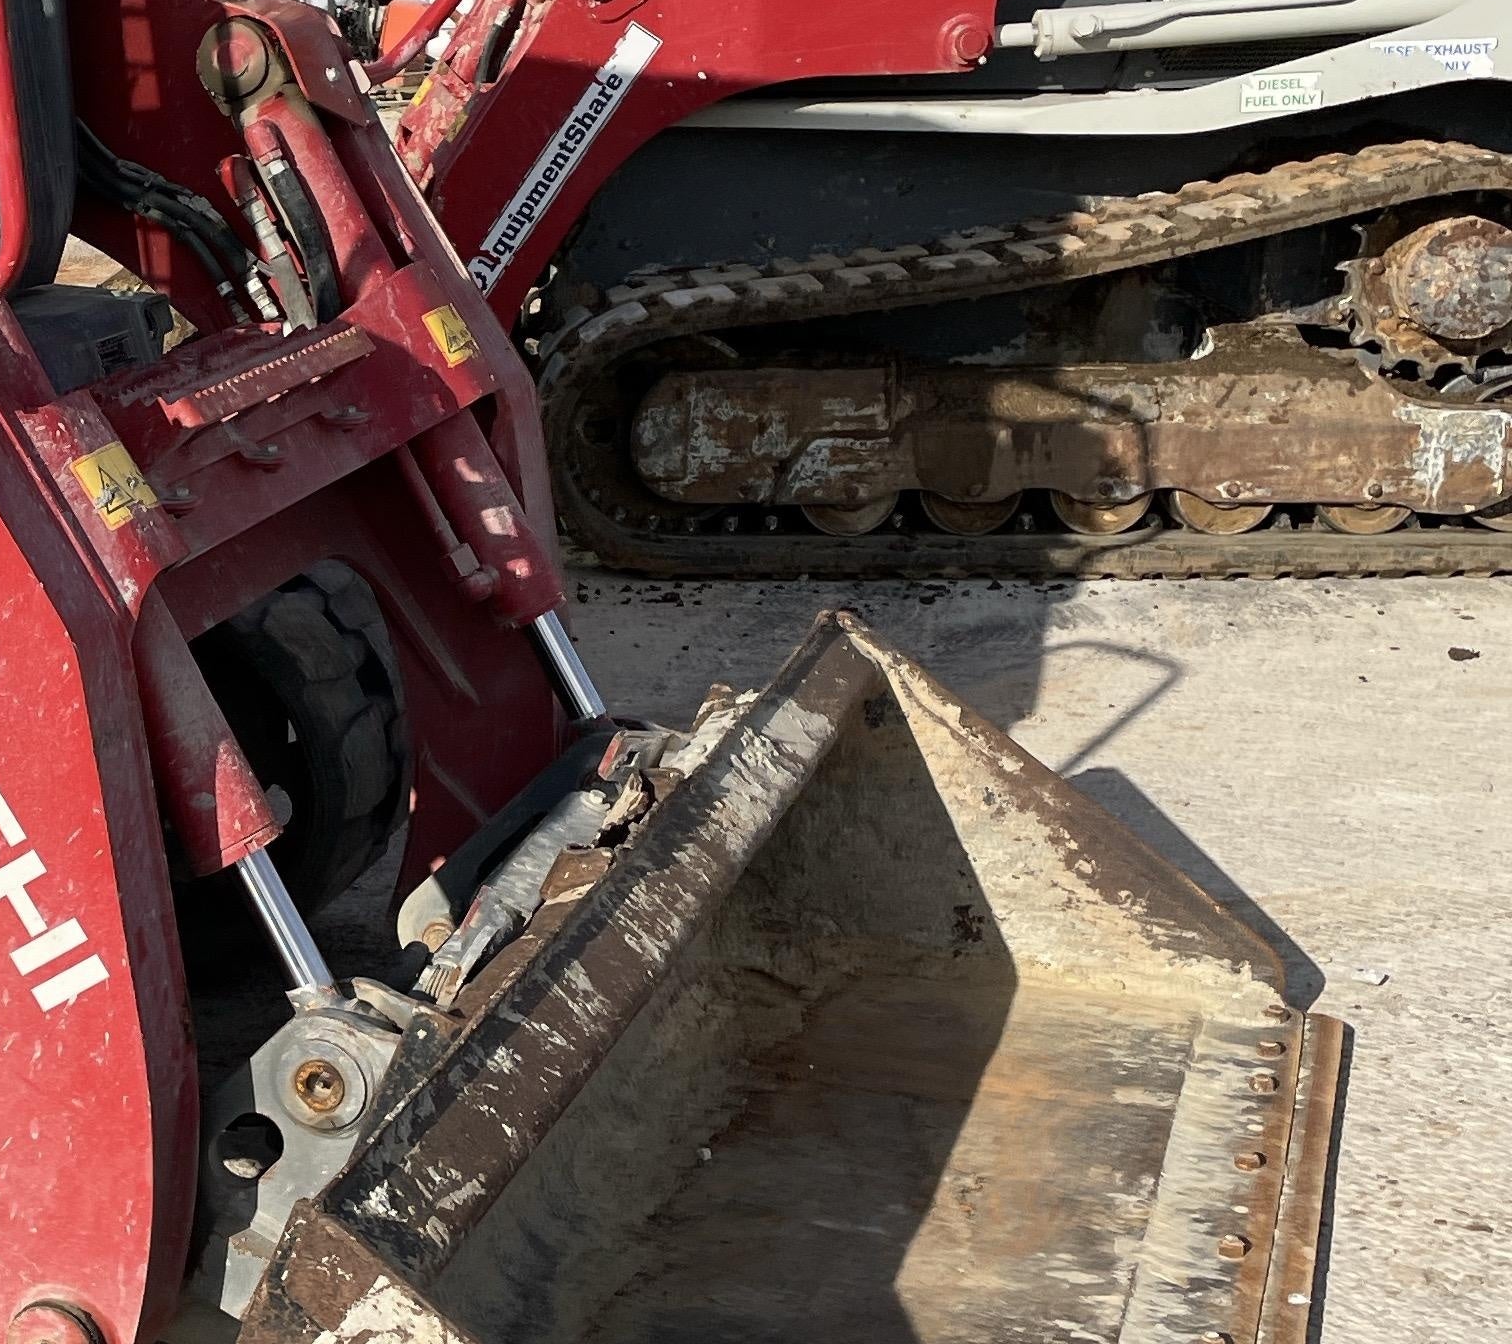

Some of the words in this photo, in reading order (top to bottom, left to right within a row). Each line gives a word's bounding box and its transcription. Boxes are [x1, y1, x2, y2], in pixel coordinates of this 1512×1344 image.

[1425, 43, 1491, 56] EXHAUST
[1258, 79, 1304, 90] DIESEL
[1245, 95, 1277, 107] FUEL
[1282, 94, 1317, 106] ONLY
